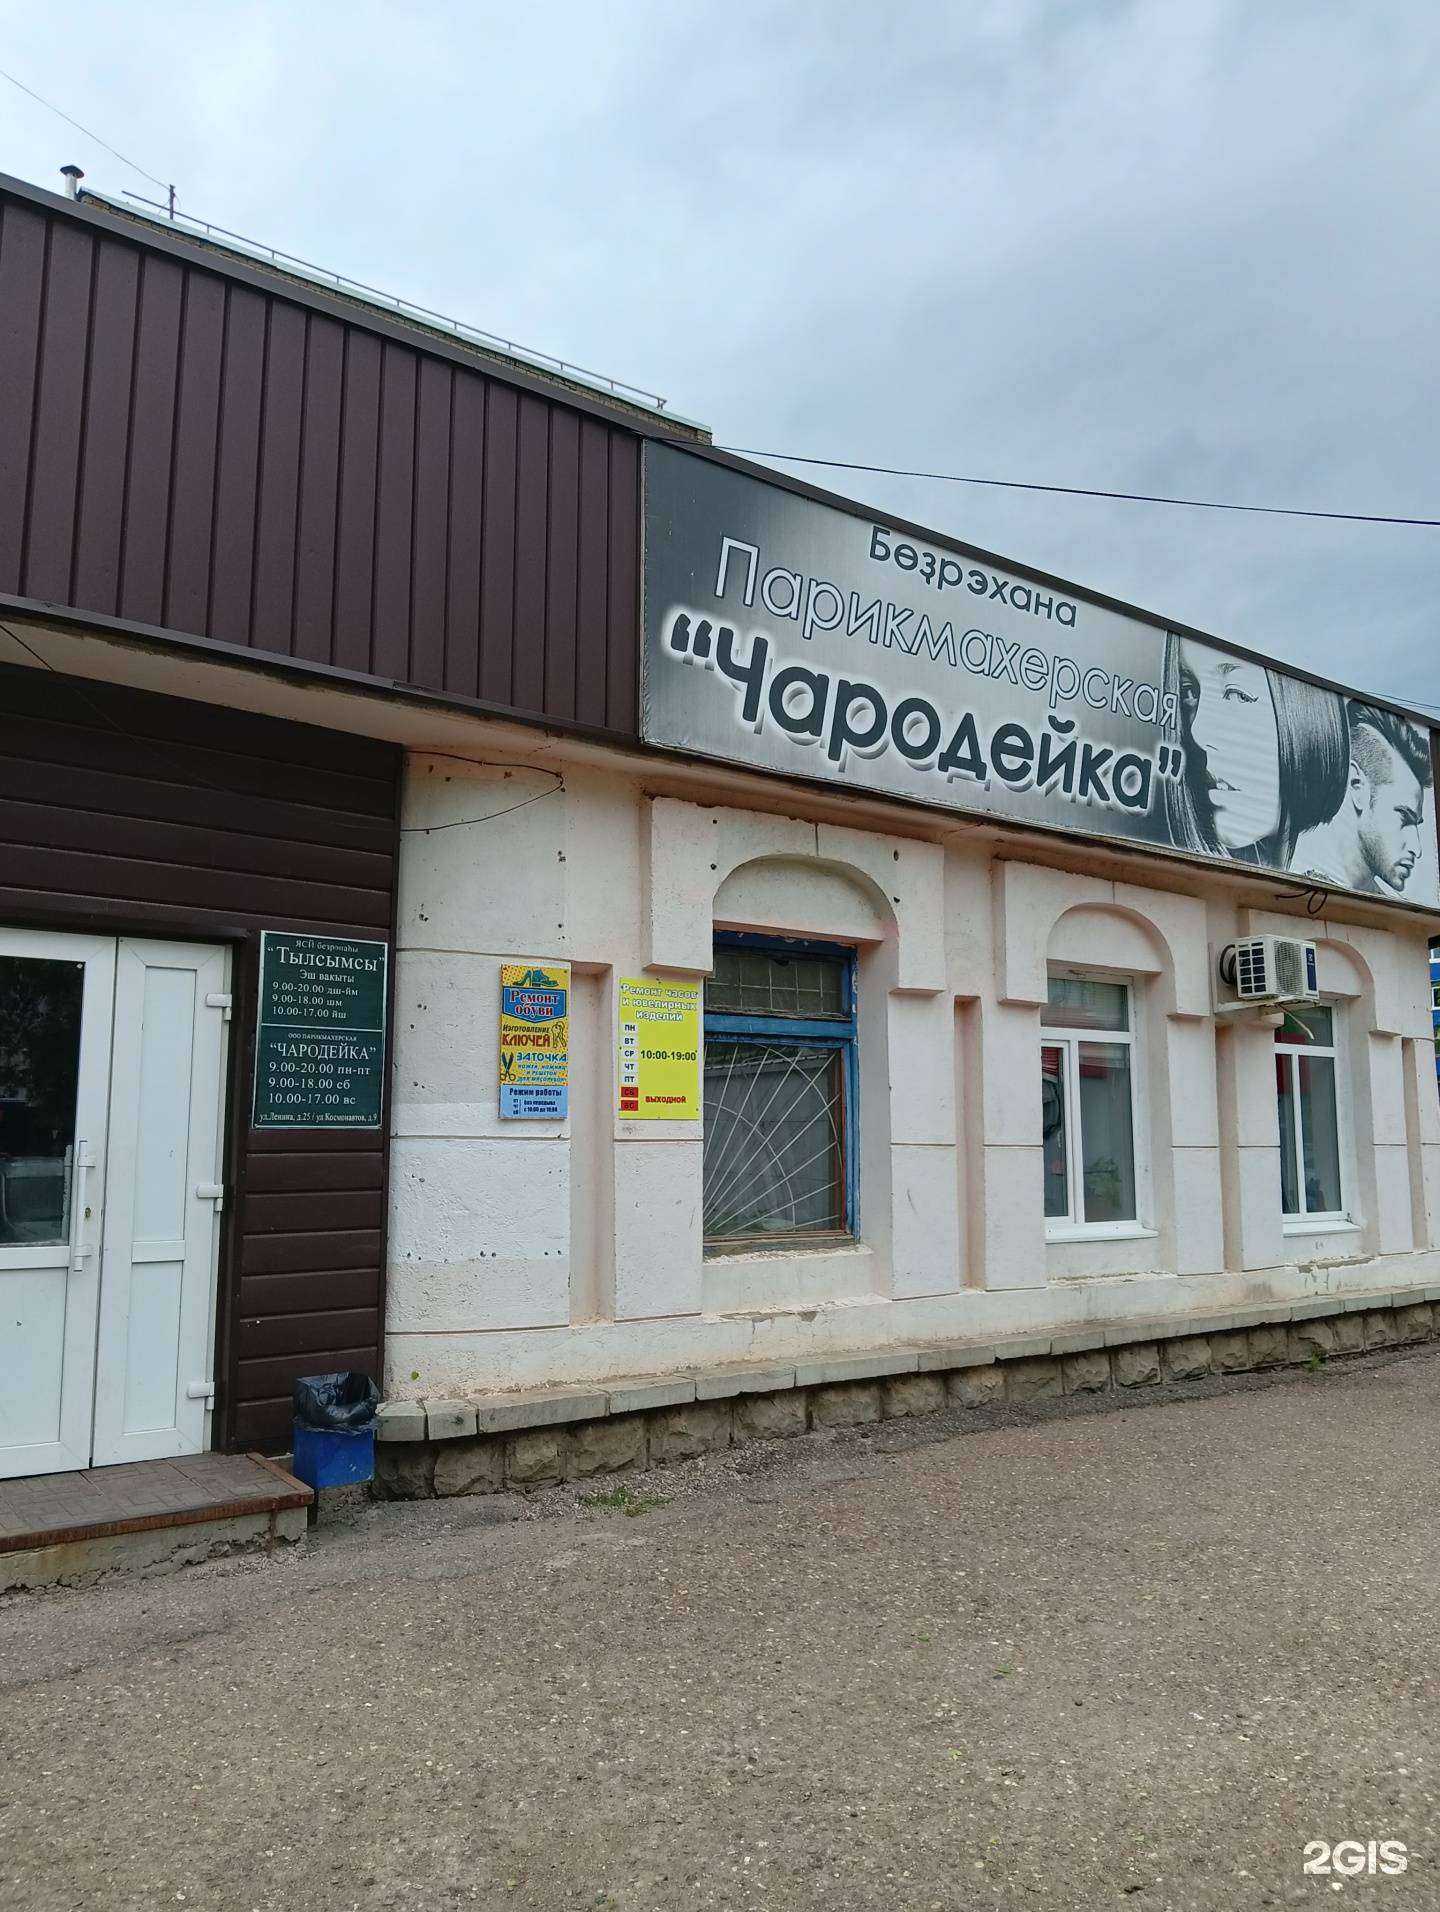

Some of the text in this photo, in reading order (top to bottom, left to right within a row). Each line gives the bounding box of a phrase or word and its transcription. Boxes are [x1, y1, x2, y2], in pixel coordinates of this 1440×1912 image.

[715, 536, 1178, 730] Парикмахерская
[671, 613, 1182, 810] “Чародейка”
[300, 969, 316, 979] Эш
[272, 981, 324, 994] 9.00-20.00
[622, 983, 699, 998] Ремонт часов
[271, 994, 324, 1005] 9.00-18.00
[509, 988, 558, 1005] Ремонт
[633, 999, 697, 1011] ювелирных
[272, 1006, 347, 1019] 10.00-17.00 йш
[636, 1010, 684, 1021] изделий
[502, 1033, 550, 1047] КЛЮЧЕЙ
[517, 1052, 567, 1062] ЗАТОЧКА
[641, 1050, 696, 1061] 10:00-19:00
[269, 1062, 371, 1075] 9.00-20.00 пн-пт
[268, 1078, 351, 1089] 9.00-18.00 сб
[269, 1093, 340, 1104] 10.00-17.00
[509, 1088, 562, 1097] Режим работы
